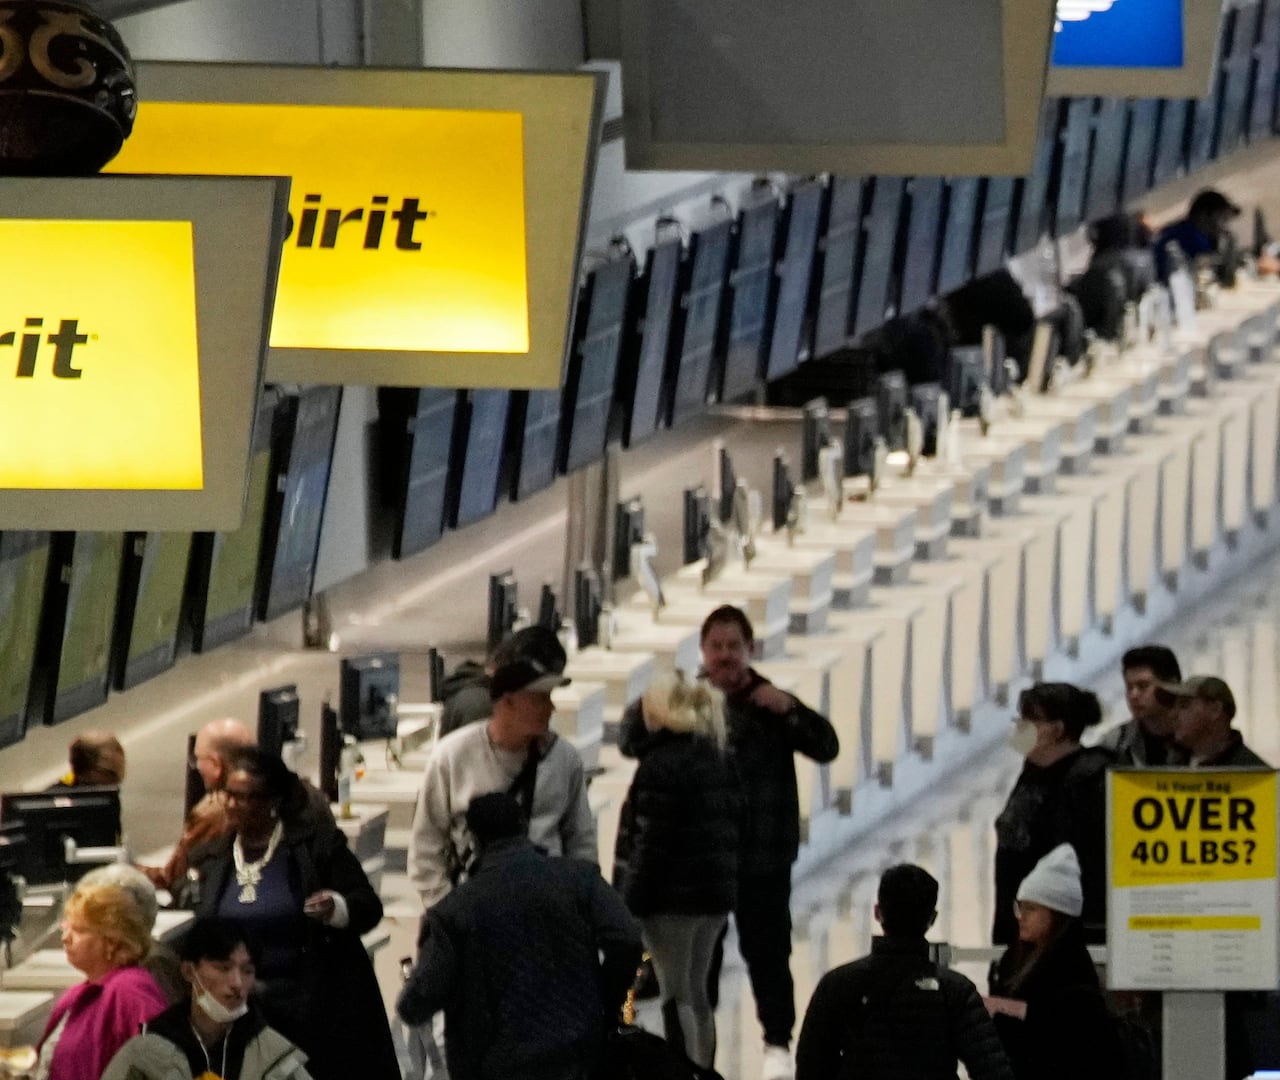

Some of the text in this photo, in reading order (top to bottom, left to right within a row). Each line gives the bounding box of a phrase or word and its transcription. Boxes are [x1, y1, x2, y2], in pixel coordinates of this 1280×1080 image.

[1172, 782, 1201, 792] Your
[1206, 781, 1231, 794] Bag
[1133, 797, 1256, 832] OVER
[1131, 840, 1257, 865] 40 LBS?
